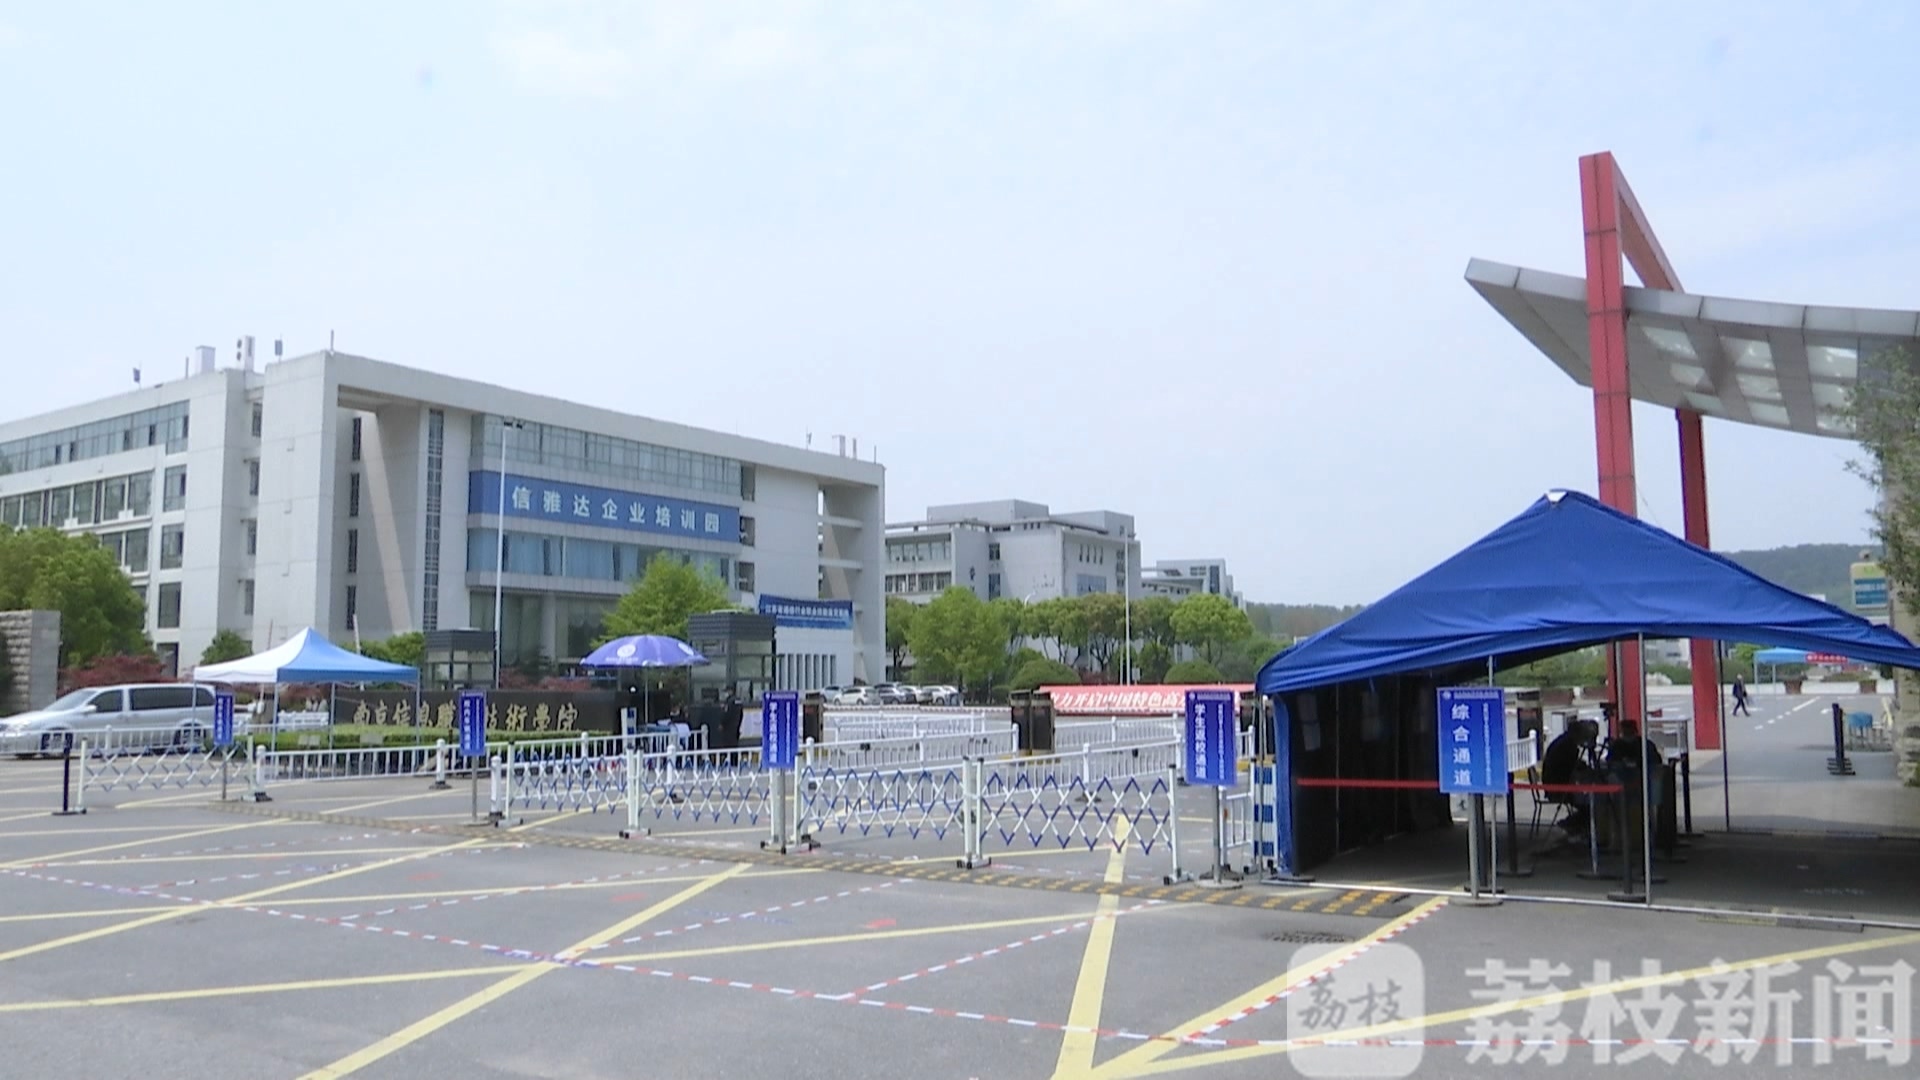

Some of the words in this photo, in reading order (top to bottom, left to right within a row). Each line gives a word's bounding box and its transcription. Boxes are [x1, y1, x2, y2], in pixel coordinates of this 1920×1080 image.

[512, 486, 720, 533] 信雅达企业培训园
[1194, 703, 1207, 779] 学生返校通道
[1451, 703, 1472, 786] 综合通道
